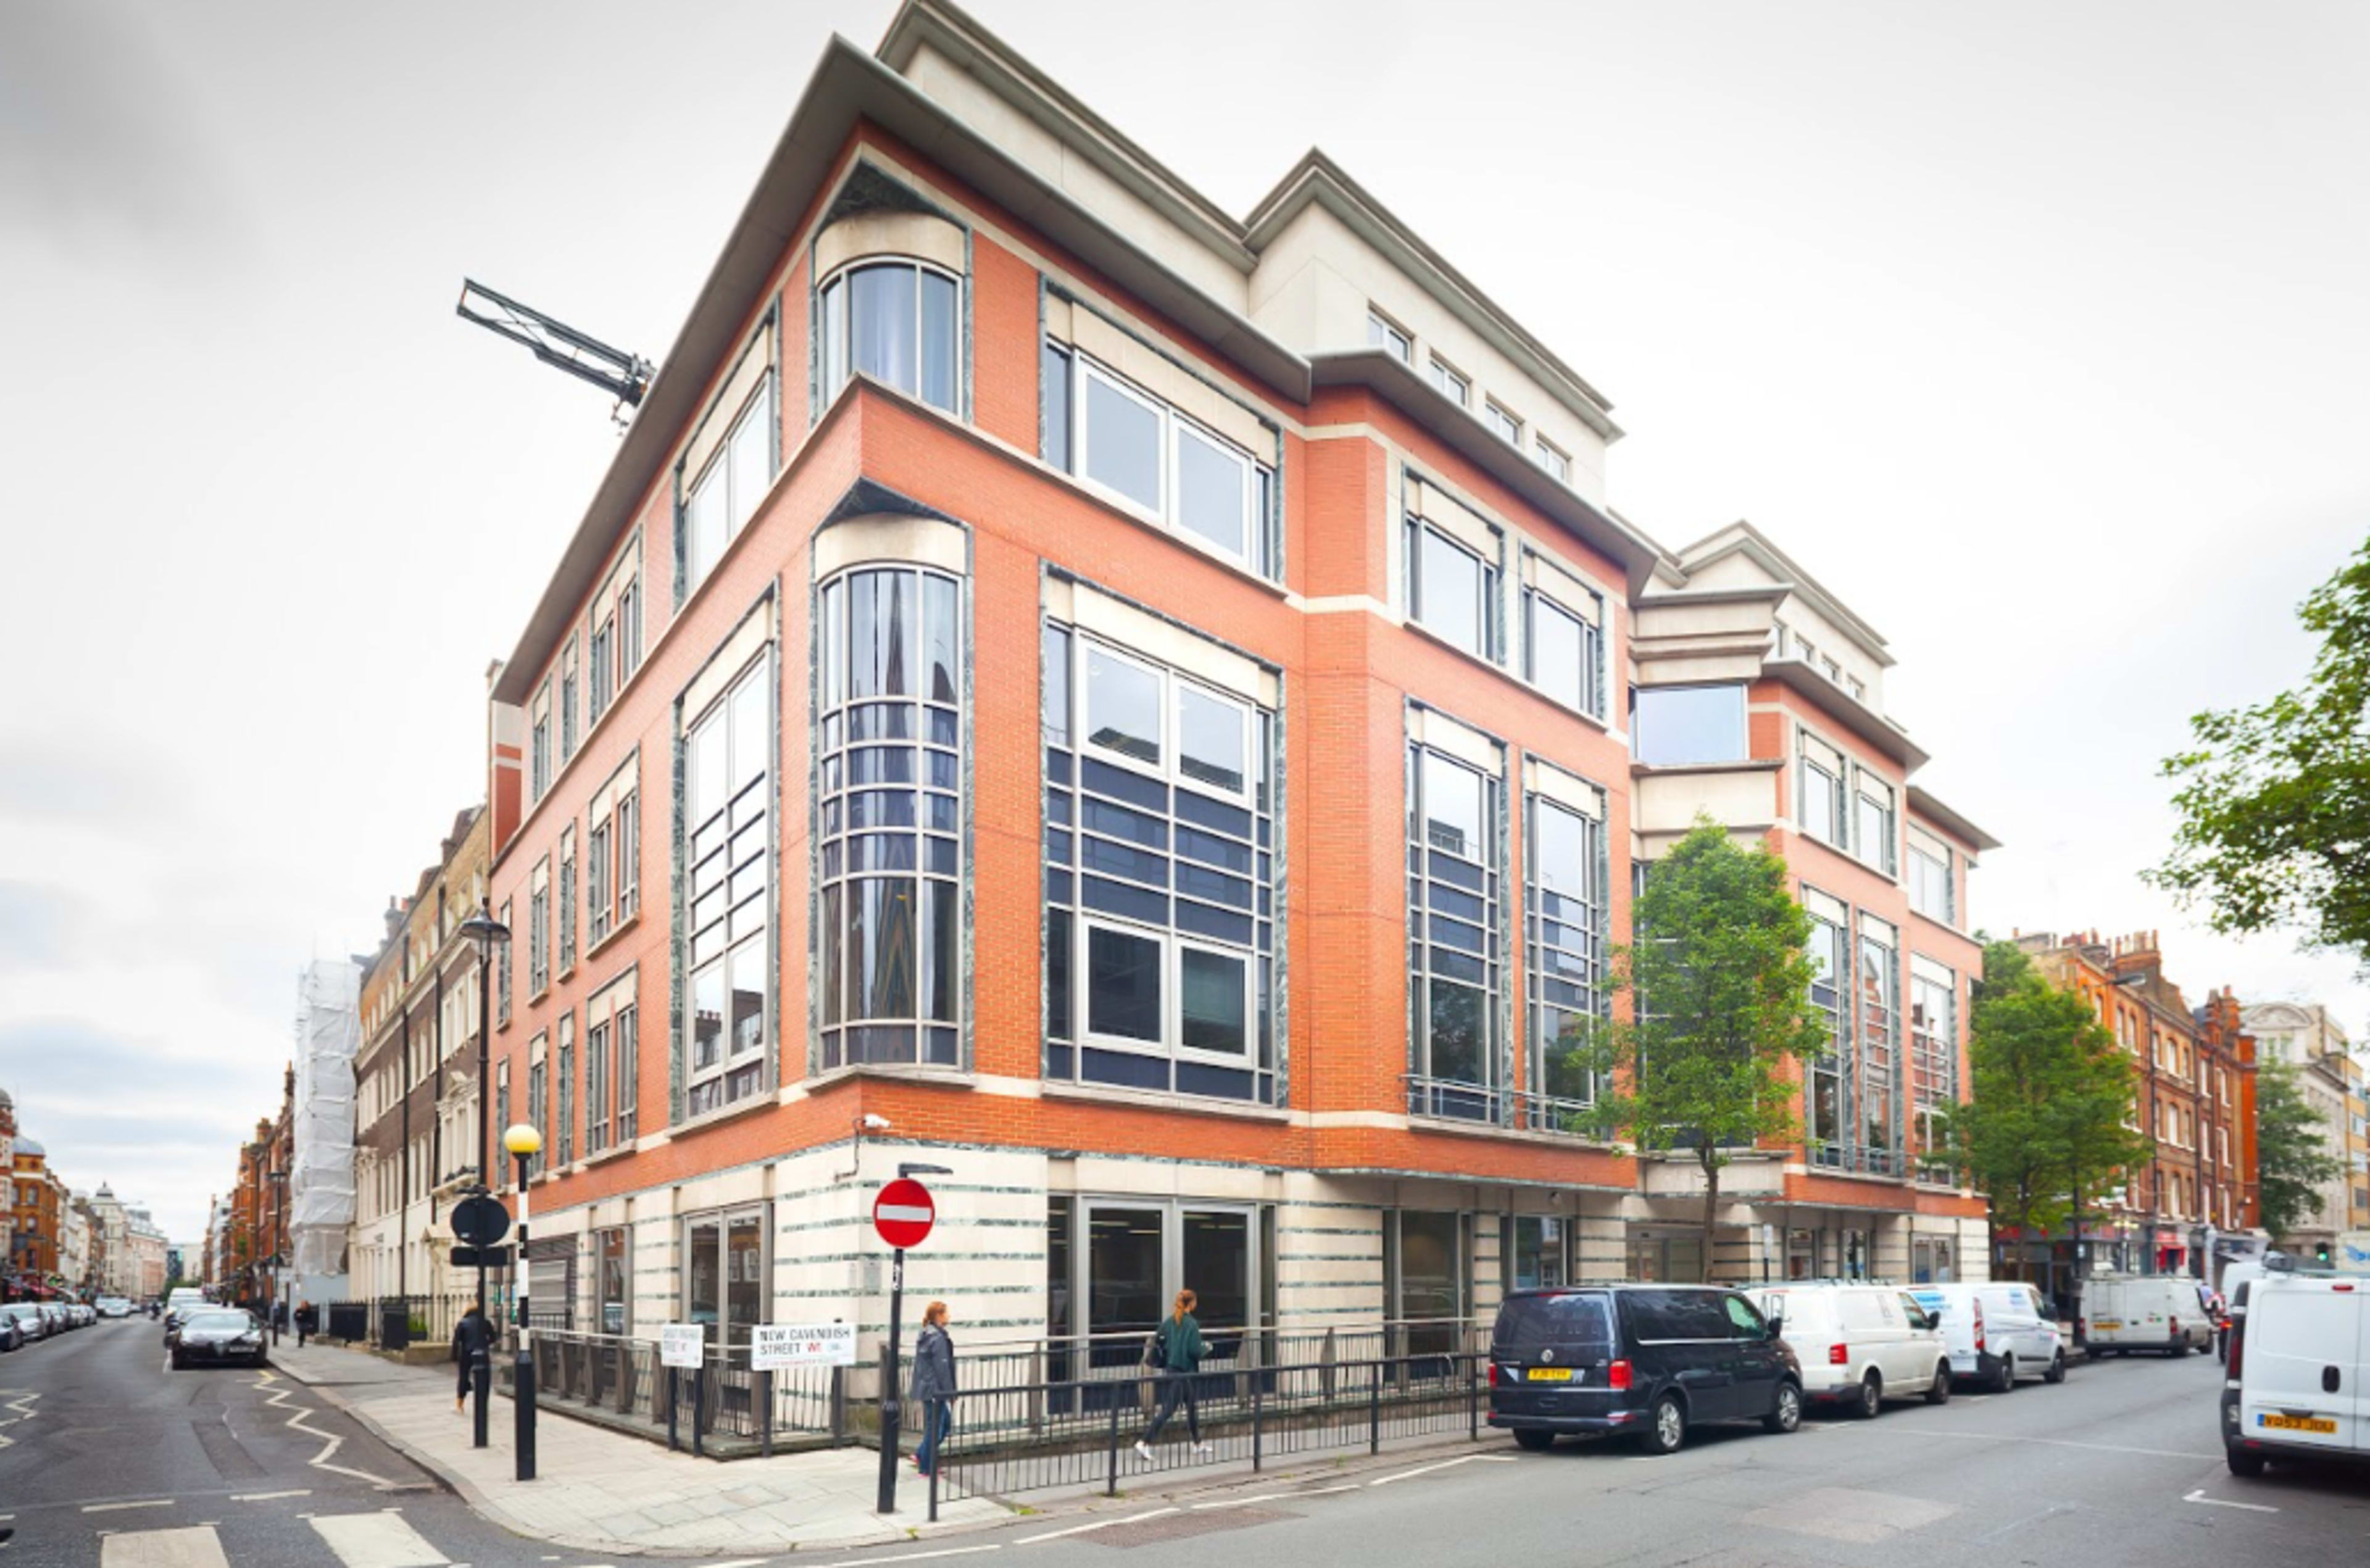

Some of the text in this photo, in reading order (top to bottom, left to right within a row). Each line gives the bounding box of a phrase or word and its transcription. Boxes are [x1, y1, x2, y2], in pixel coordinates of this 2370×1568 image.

[760, 1327, 850, 1341] NEW CAVENDISH
[760, 1342, 800, 1355] STREET
